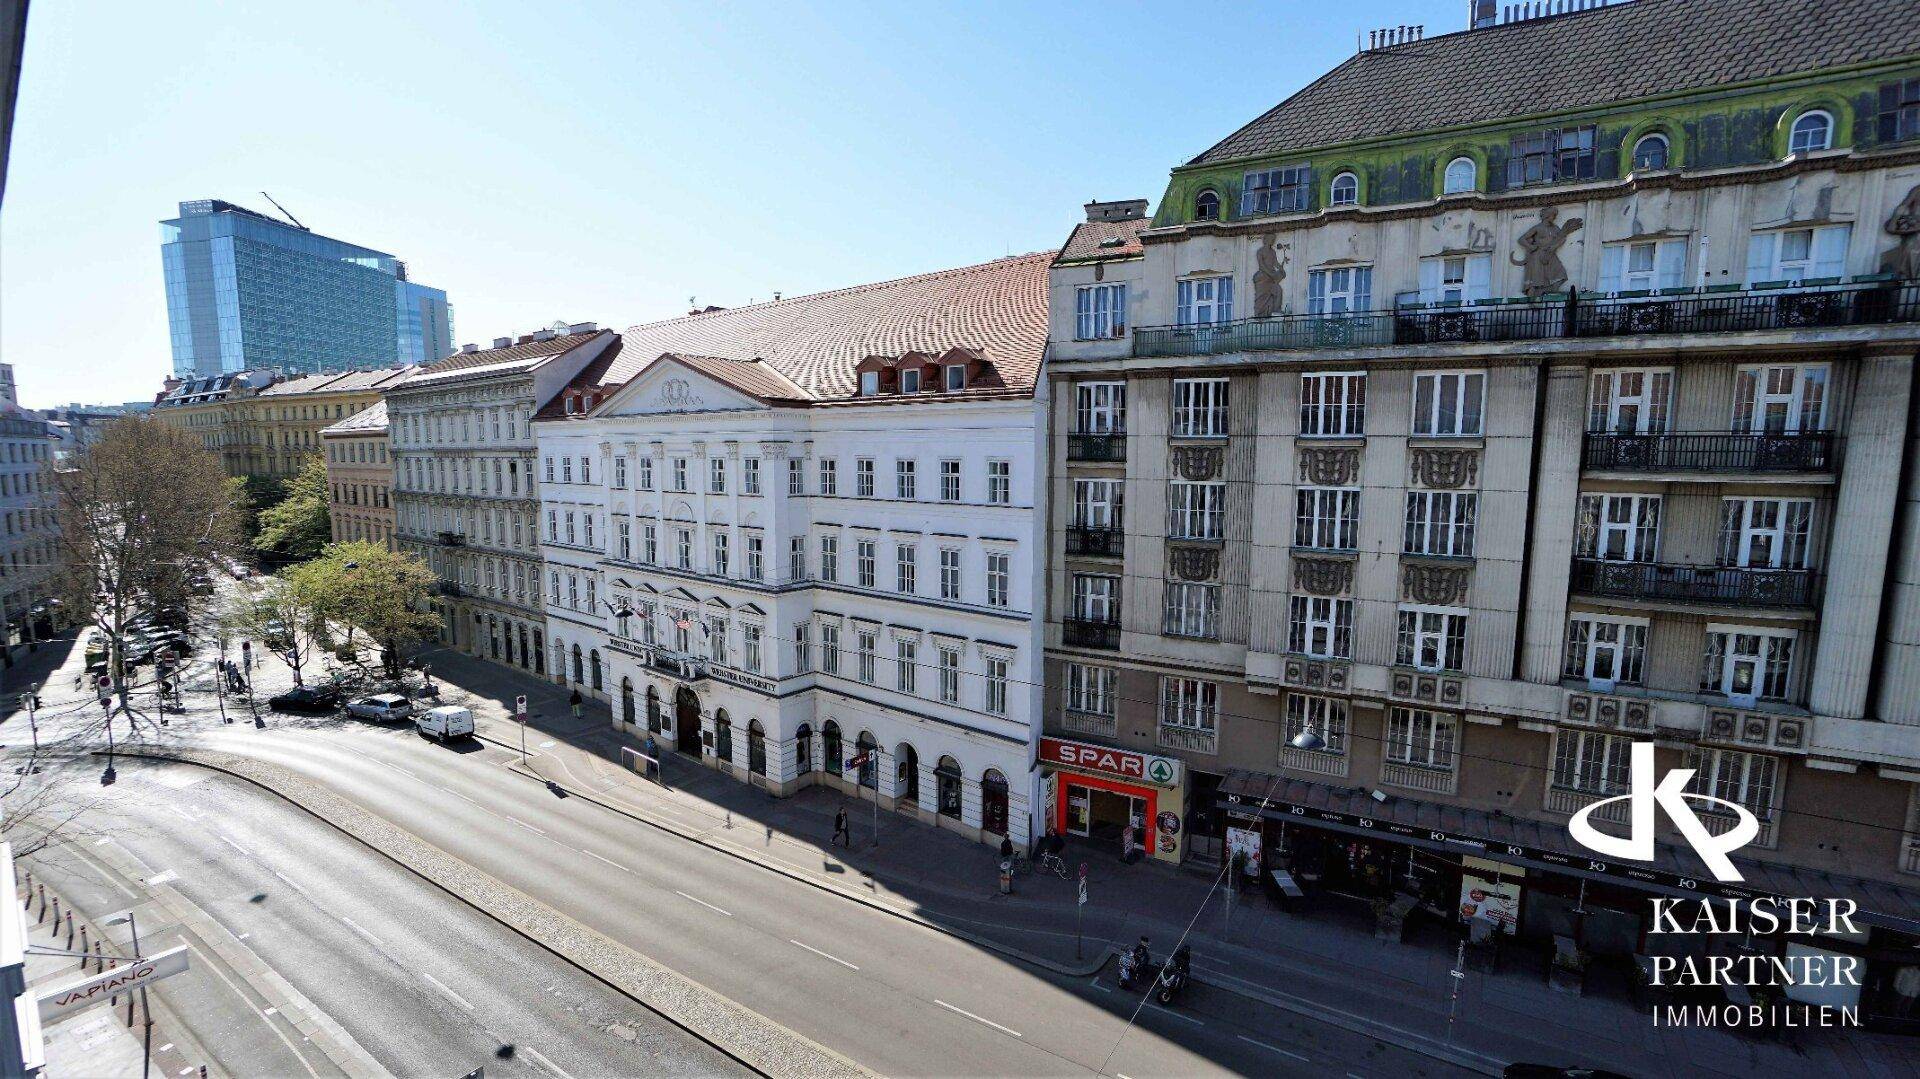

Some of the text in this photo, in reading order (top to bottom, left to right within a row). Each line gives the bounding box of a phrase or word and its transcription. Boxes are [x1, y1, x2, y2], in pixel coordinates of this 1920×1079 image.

[711, 667, 776, 692] WEBSTER UNIVERSITY
[1059, 745, 1142, 775] SPAR
